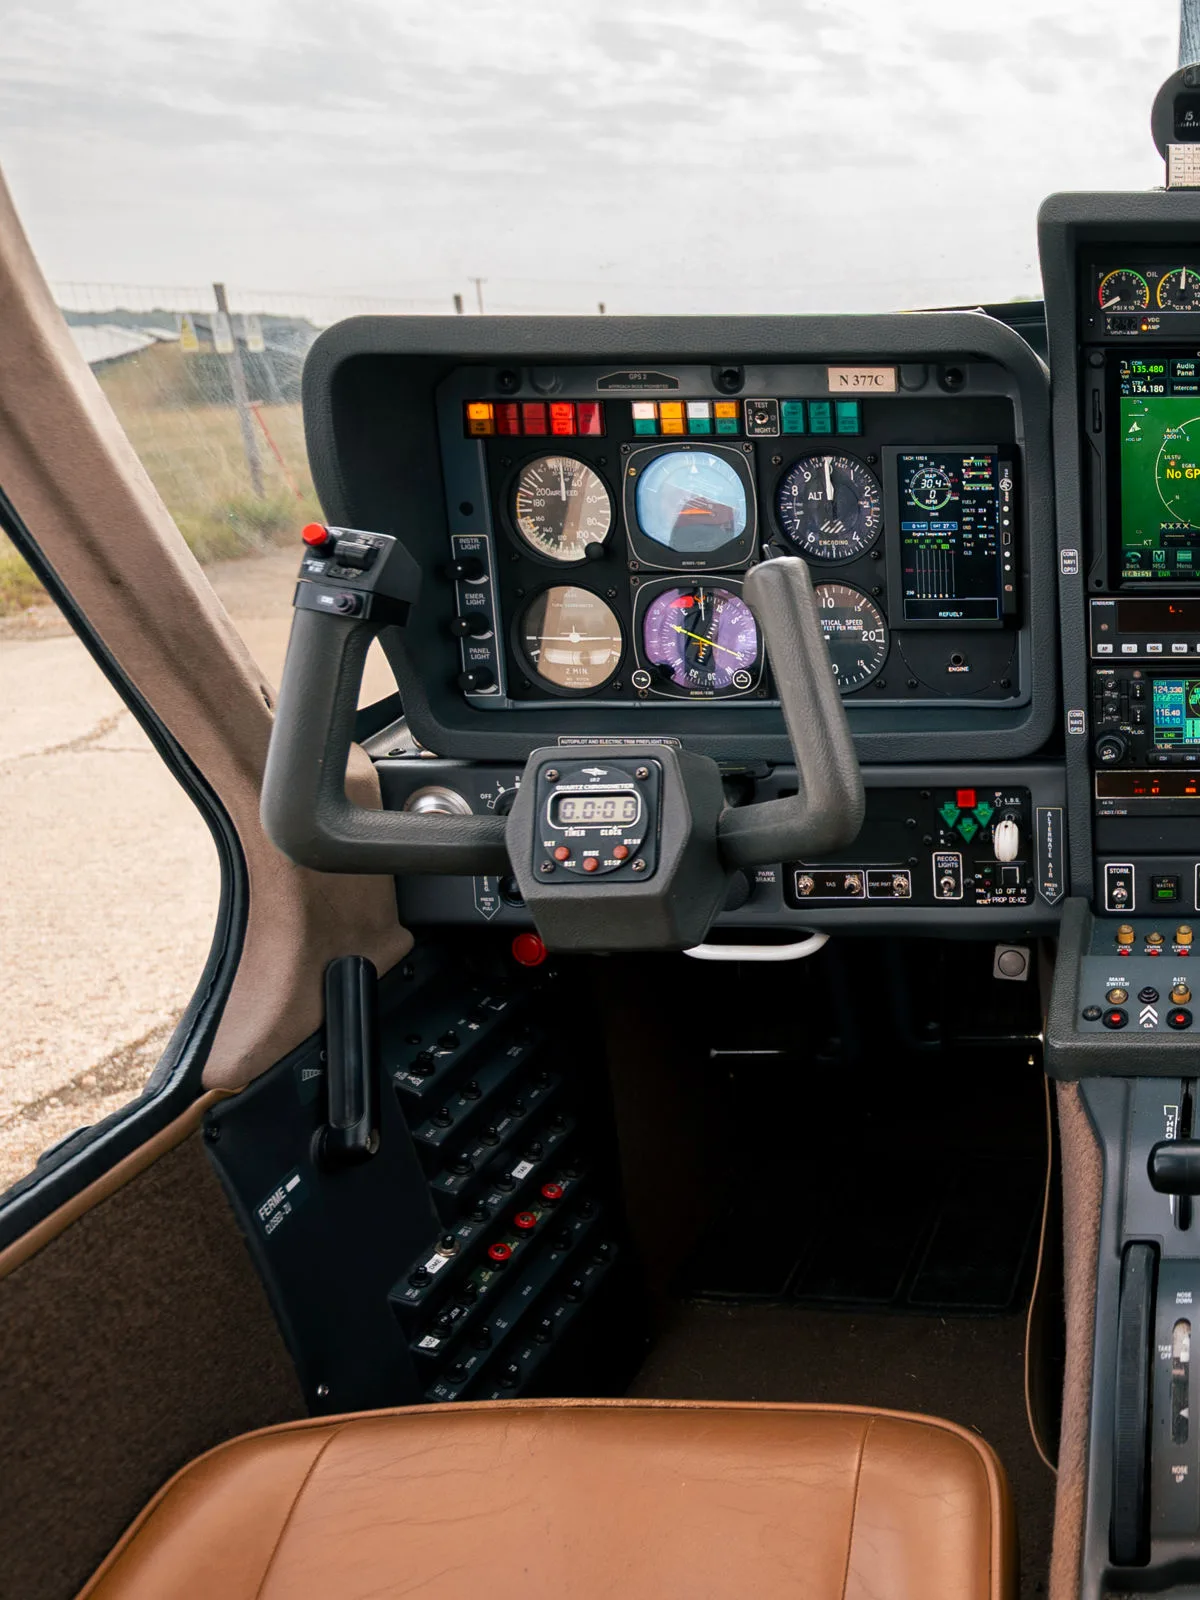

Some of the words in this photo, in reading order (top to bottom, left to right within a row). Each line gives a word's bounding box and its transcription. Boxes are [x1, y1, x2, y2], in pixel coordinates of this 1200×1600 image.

[840, 375, 849, 386] N
[853, 375, 884, 386] 377C
[804, 472, 812, 482] 9
[1166, 469, 1183, 479] No
[572, 479, 582, 487] 40
[921, 479, 941, 488] 30.4
[536, 488, 551, 496] 200
[792, 485, 799, 496] 8
[865, 486, 871, 496] 2
[808, 492, 823, 500] ALT
[534, 499, 545, 507] 180
[587, 517, 598, 525] 80
[576, 530, 590, 539] 100
[807, 532, 816, 542] 6
[852, 531, 860, 541] 4
[822, 598, 835, 608] 10
[862, 631, 876, 641] 20
[1165, 1114, 1174, 1139] THRO
[517, 1165, 528, 1175] TAS
[258, 1186, 287, 1221] FERME
[429, 1259, 441, 1270] DME
[1172, 1465, 1188, 1475] NOSE
[1176, 1475, 1184, 1483] UP
